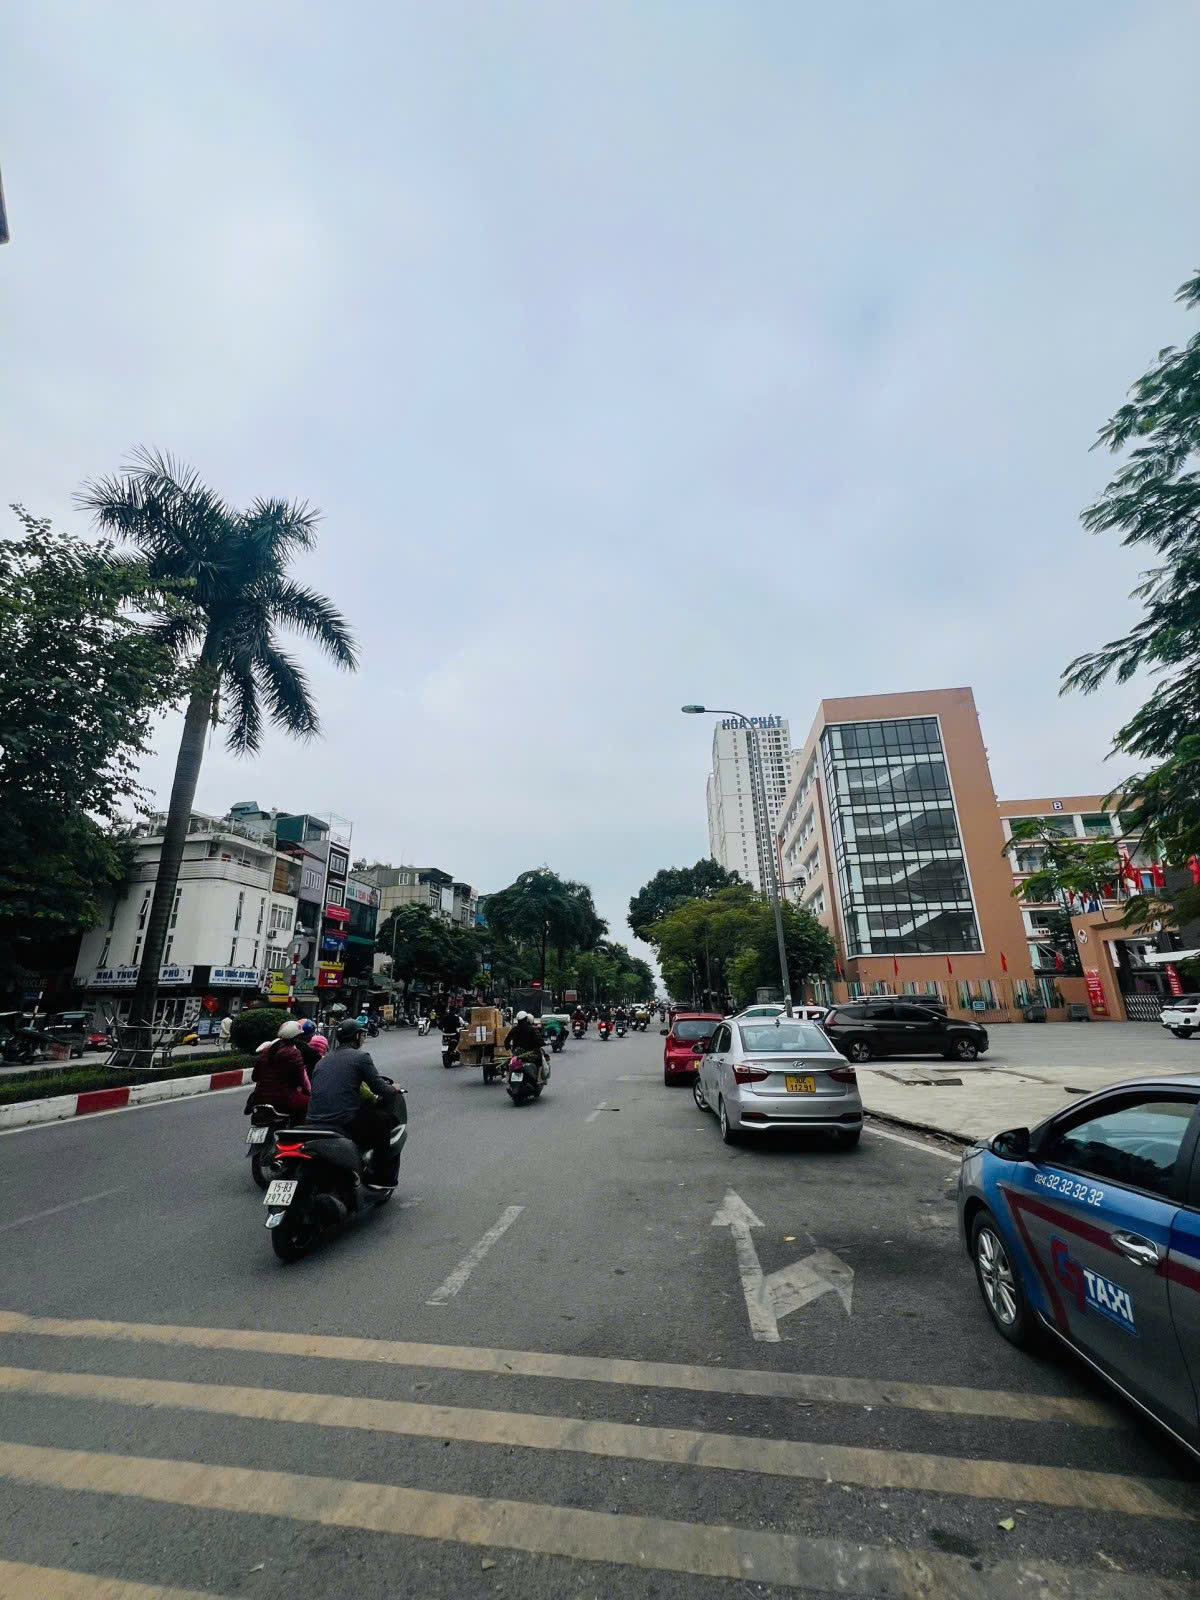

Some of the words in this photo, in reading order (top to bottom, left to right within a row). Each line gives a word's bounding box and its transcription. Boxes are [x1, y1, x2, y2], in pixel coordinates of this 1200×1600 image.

[722, 716, 747, 730] HÒA
[750, 714, 781, 729] PHÁT
[1052, 800, 1064, 811] B
[117, 968, 139, 979] THUỐ
[1059, 1179, 1074, 1195] 32
[1072, 1183, 1088, 1201] 32
[1087, 1188, 1105, 1207] 32
[1083, 1269, 1135, 1324] TAXI
